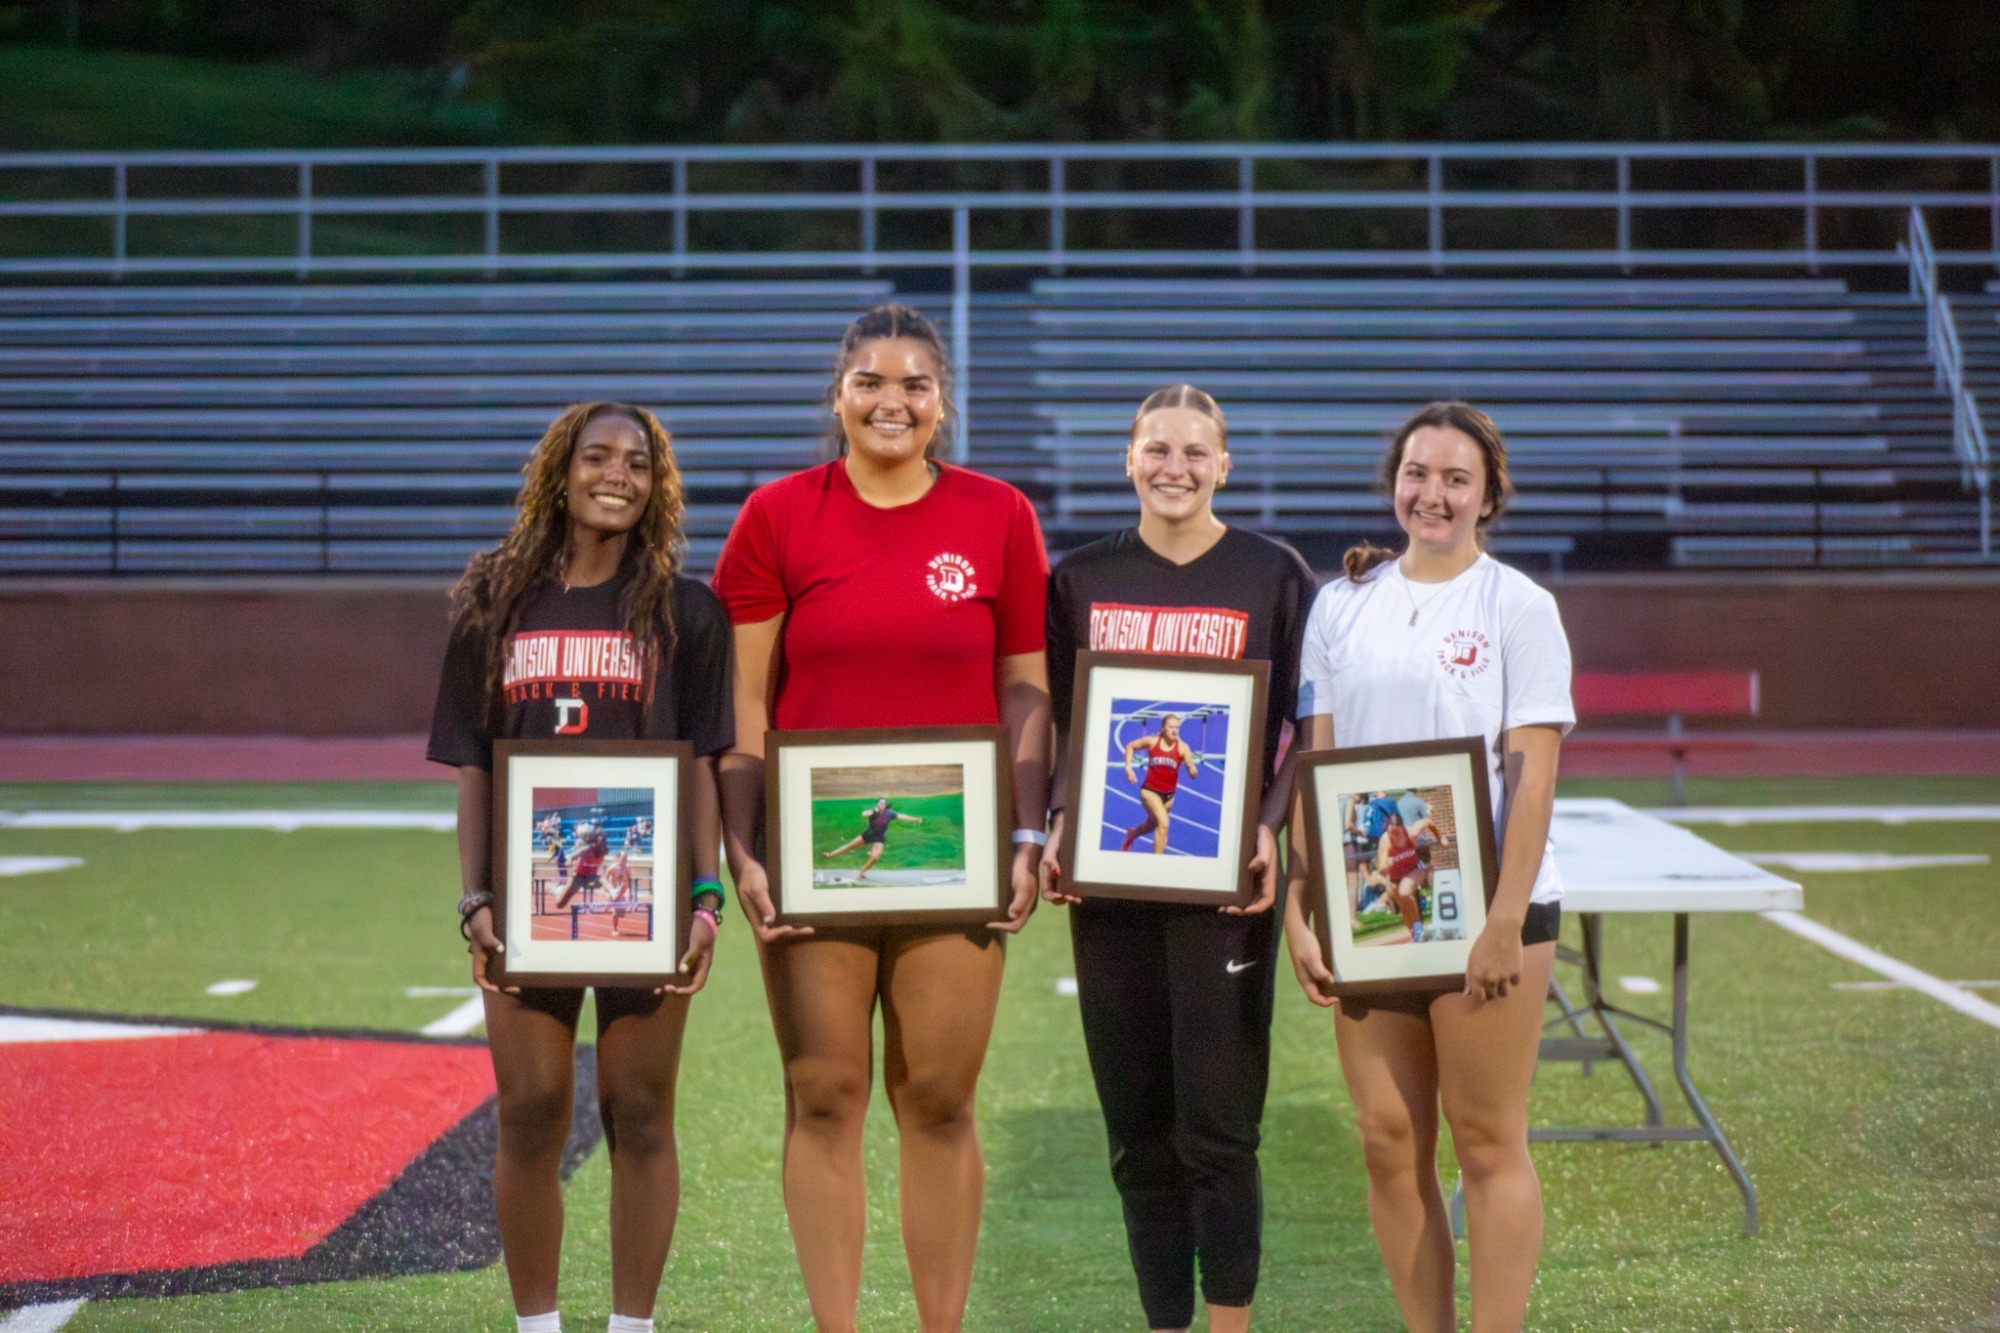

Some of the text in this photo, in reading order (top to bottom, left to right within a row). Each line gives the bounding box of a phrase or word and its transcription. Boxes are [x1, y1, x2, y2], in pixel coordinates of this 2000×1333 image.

[1090, 609, 1244, 660] DENISON UNIVERSITY
[1443, 629, 1490, 649] DENISON
[1450, 641, 1477, 667] D
[554, 698, 589, 735] D
[1438, 891, 1458, 921] 8
